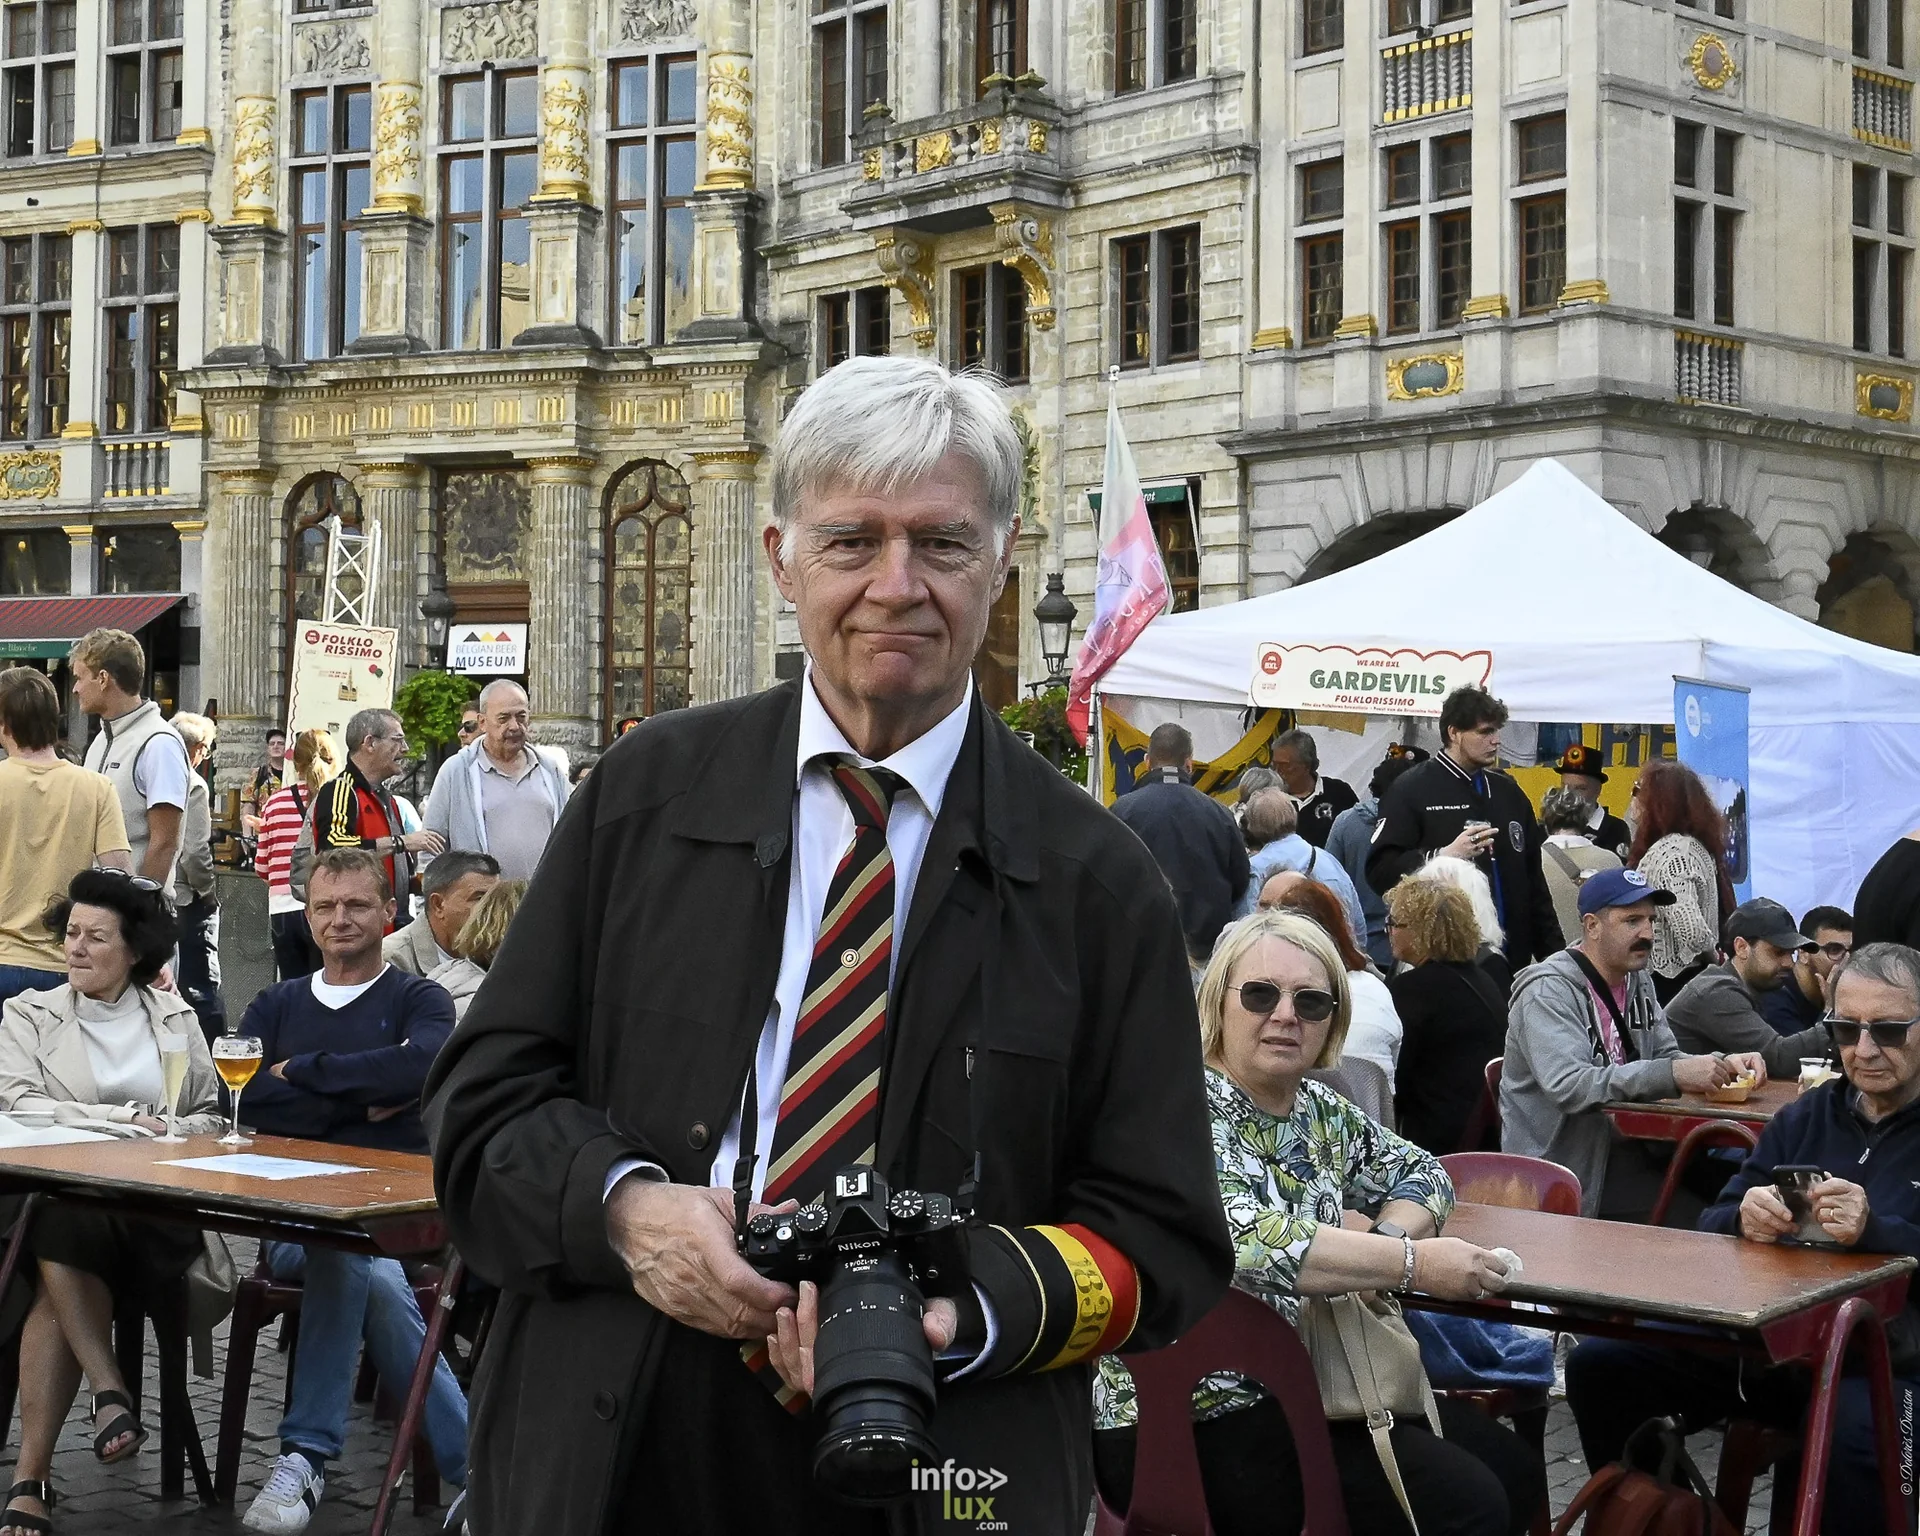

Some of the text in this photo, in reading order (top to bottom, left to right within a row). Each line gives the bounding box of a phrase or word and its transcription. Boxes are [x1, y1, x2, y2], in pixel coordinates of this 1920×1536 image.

[1143, 491, 1156, 502] rot
[321, 634, 374, 648] FOLKLO
[324, 644, 383, 658] RISSIMO
[455, 644, 518, 654] BELGIAN BEER
[455, 656, 516, 667] MUSEUM
[1309, 669, 1447, 695] GARDEVILS
[1334, 694, 1415, 707] FOLKLORISSIMO
[837, 1240, 881, 1251] Nikon
